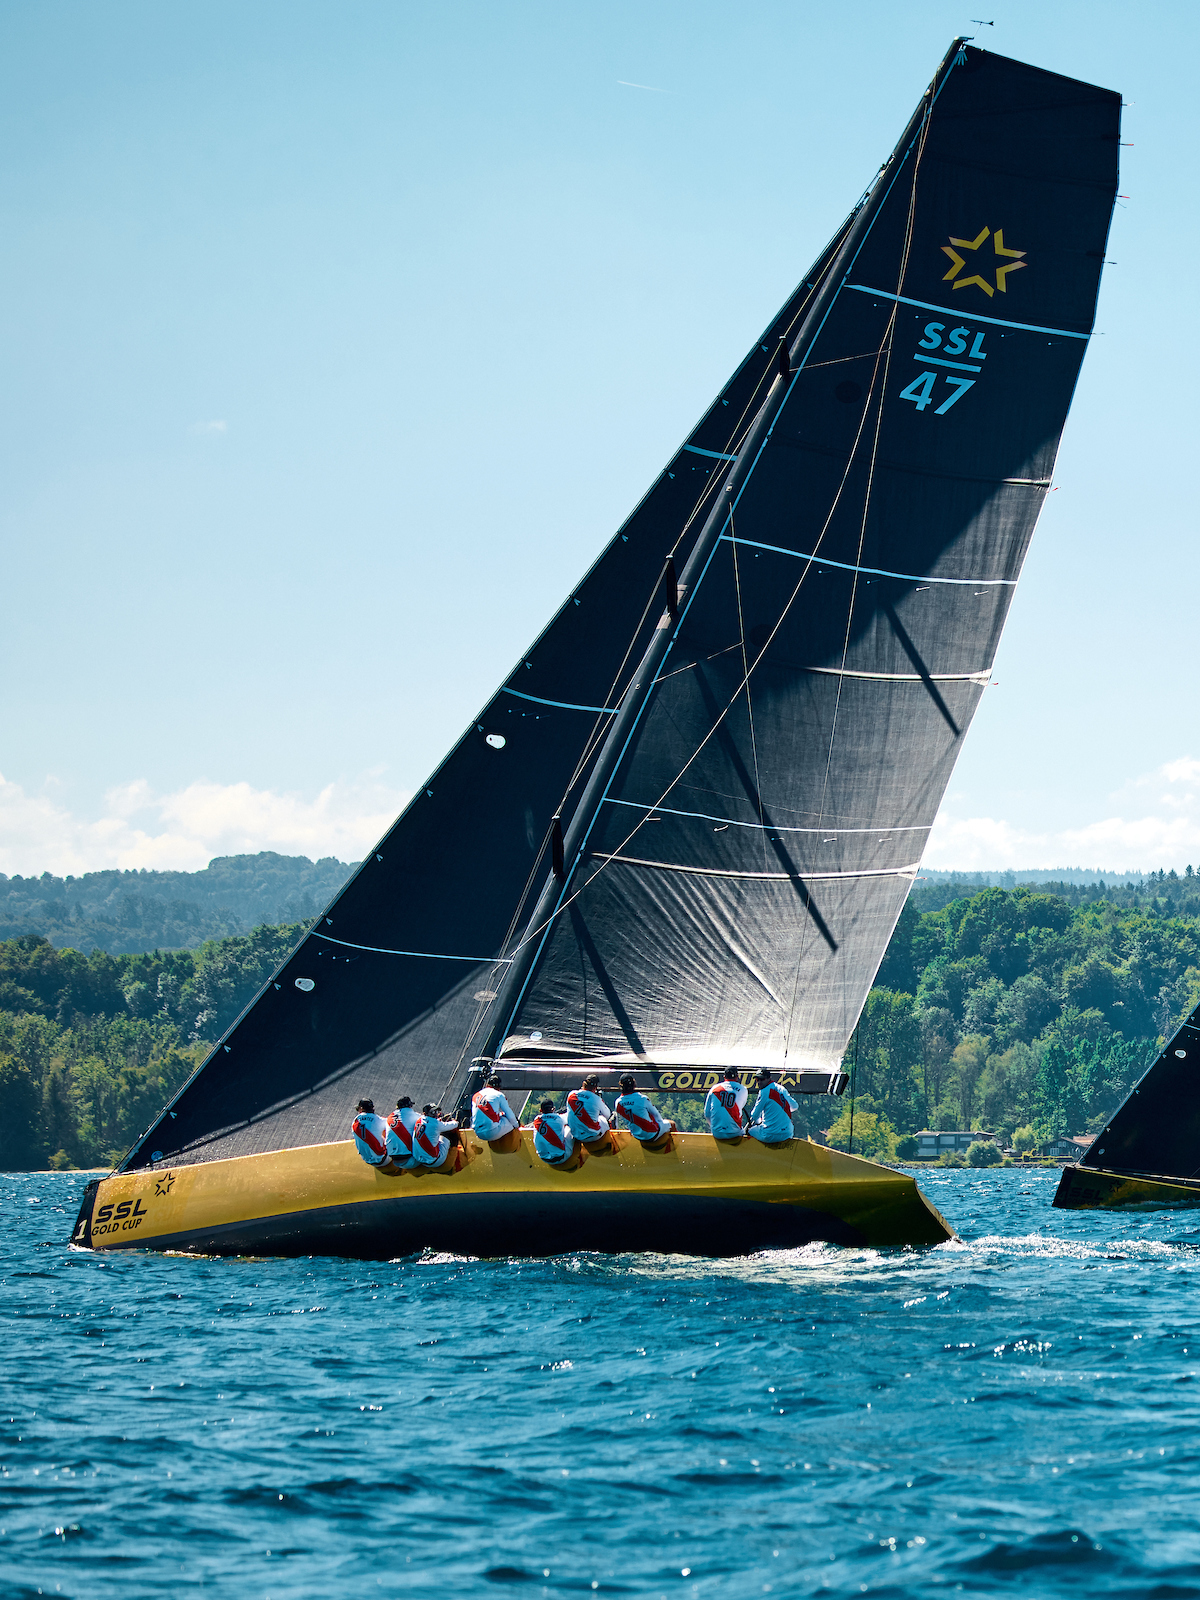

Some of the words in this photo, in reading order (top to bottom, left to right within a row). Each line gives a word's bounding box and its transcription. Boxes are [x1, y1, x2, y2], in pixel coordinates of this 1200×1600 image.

[918, 322, 987, 360] SSL
[899, 371, 977, 416] 47
[658, 1072, 719, 1089] GOLD
[575, 1101, 584, 1116] 2
[720, 1091, 736, 1108] 10
[539, 1120, 547, 1135] 6
[95, 1199, 148, 1224] SSL
[74, 1219, 87, 1240] 1
[91, 1222, 119, 1236] GOLD
[122, 1218, 142, 1231] CUP
